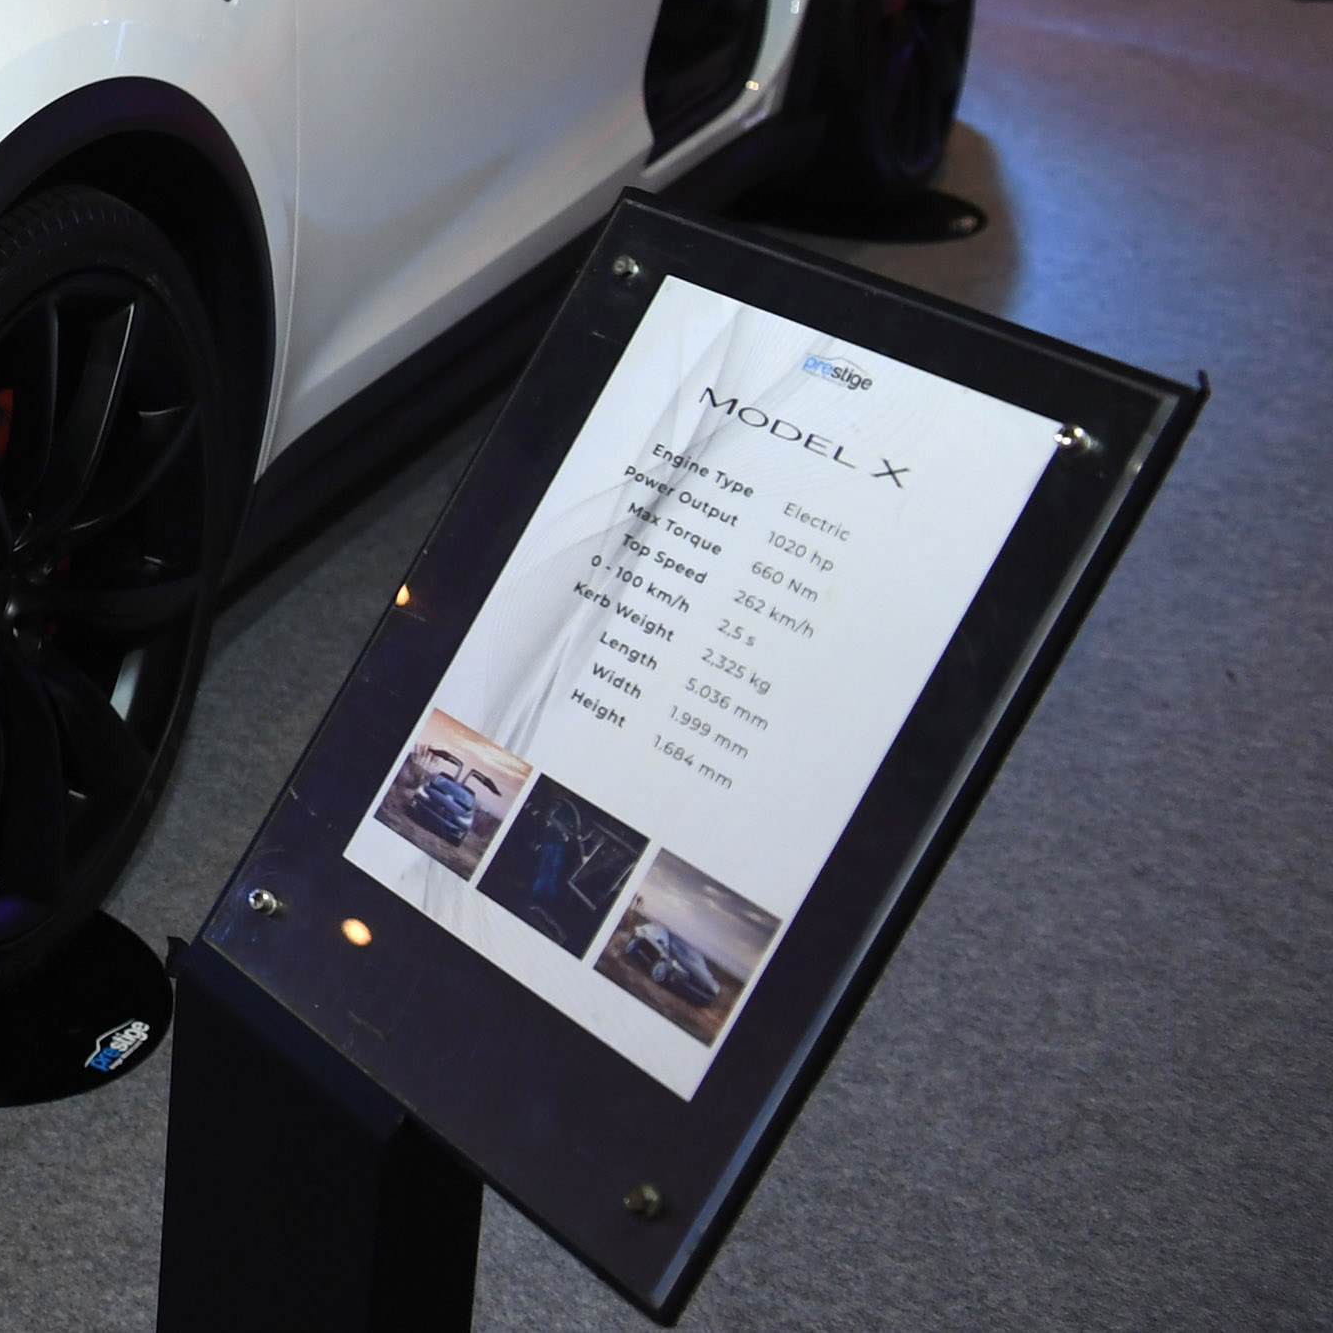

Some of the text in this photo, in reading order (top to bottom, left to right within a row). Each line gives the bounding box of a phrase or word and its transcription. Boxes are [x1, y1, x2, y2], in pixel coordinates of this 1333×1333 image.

[802, 356, 873, 390] prestige
[699, 387, 910, 489] MODEL X
[624, 465, 835, 573] Power Output 1020 hp
[652, 443, 851, 542] Engine Type Electric
[590, 555, 602, 567] 0
[614, 566, 644, 588] 100
[646, 581, 691, 613] km/h
[746, 635, 756, 647] s
[622, 533, 815, 639] Top Speed 262 km/h
[628, 502, 819, 603] Max Torque 660 Nm
[573, 581, 611, 609] Kerb
[615, 602, 675, 642] Weight
[749, 671, 771, 695] kg
[599, 631, 658, 670] Length
[733, 705, 769, 731] mm
[570, 688, 626, 728] Height
[698, 762, 733, 789] mm
[592, 662, 642, 699] Width
[714, 732, 749, 759] mm
